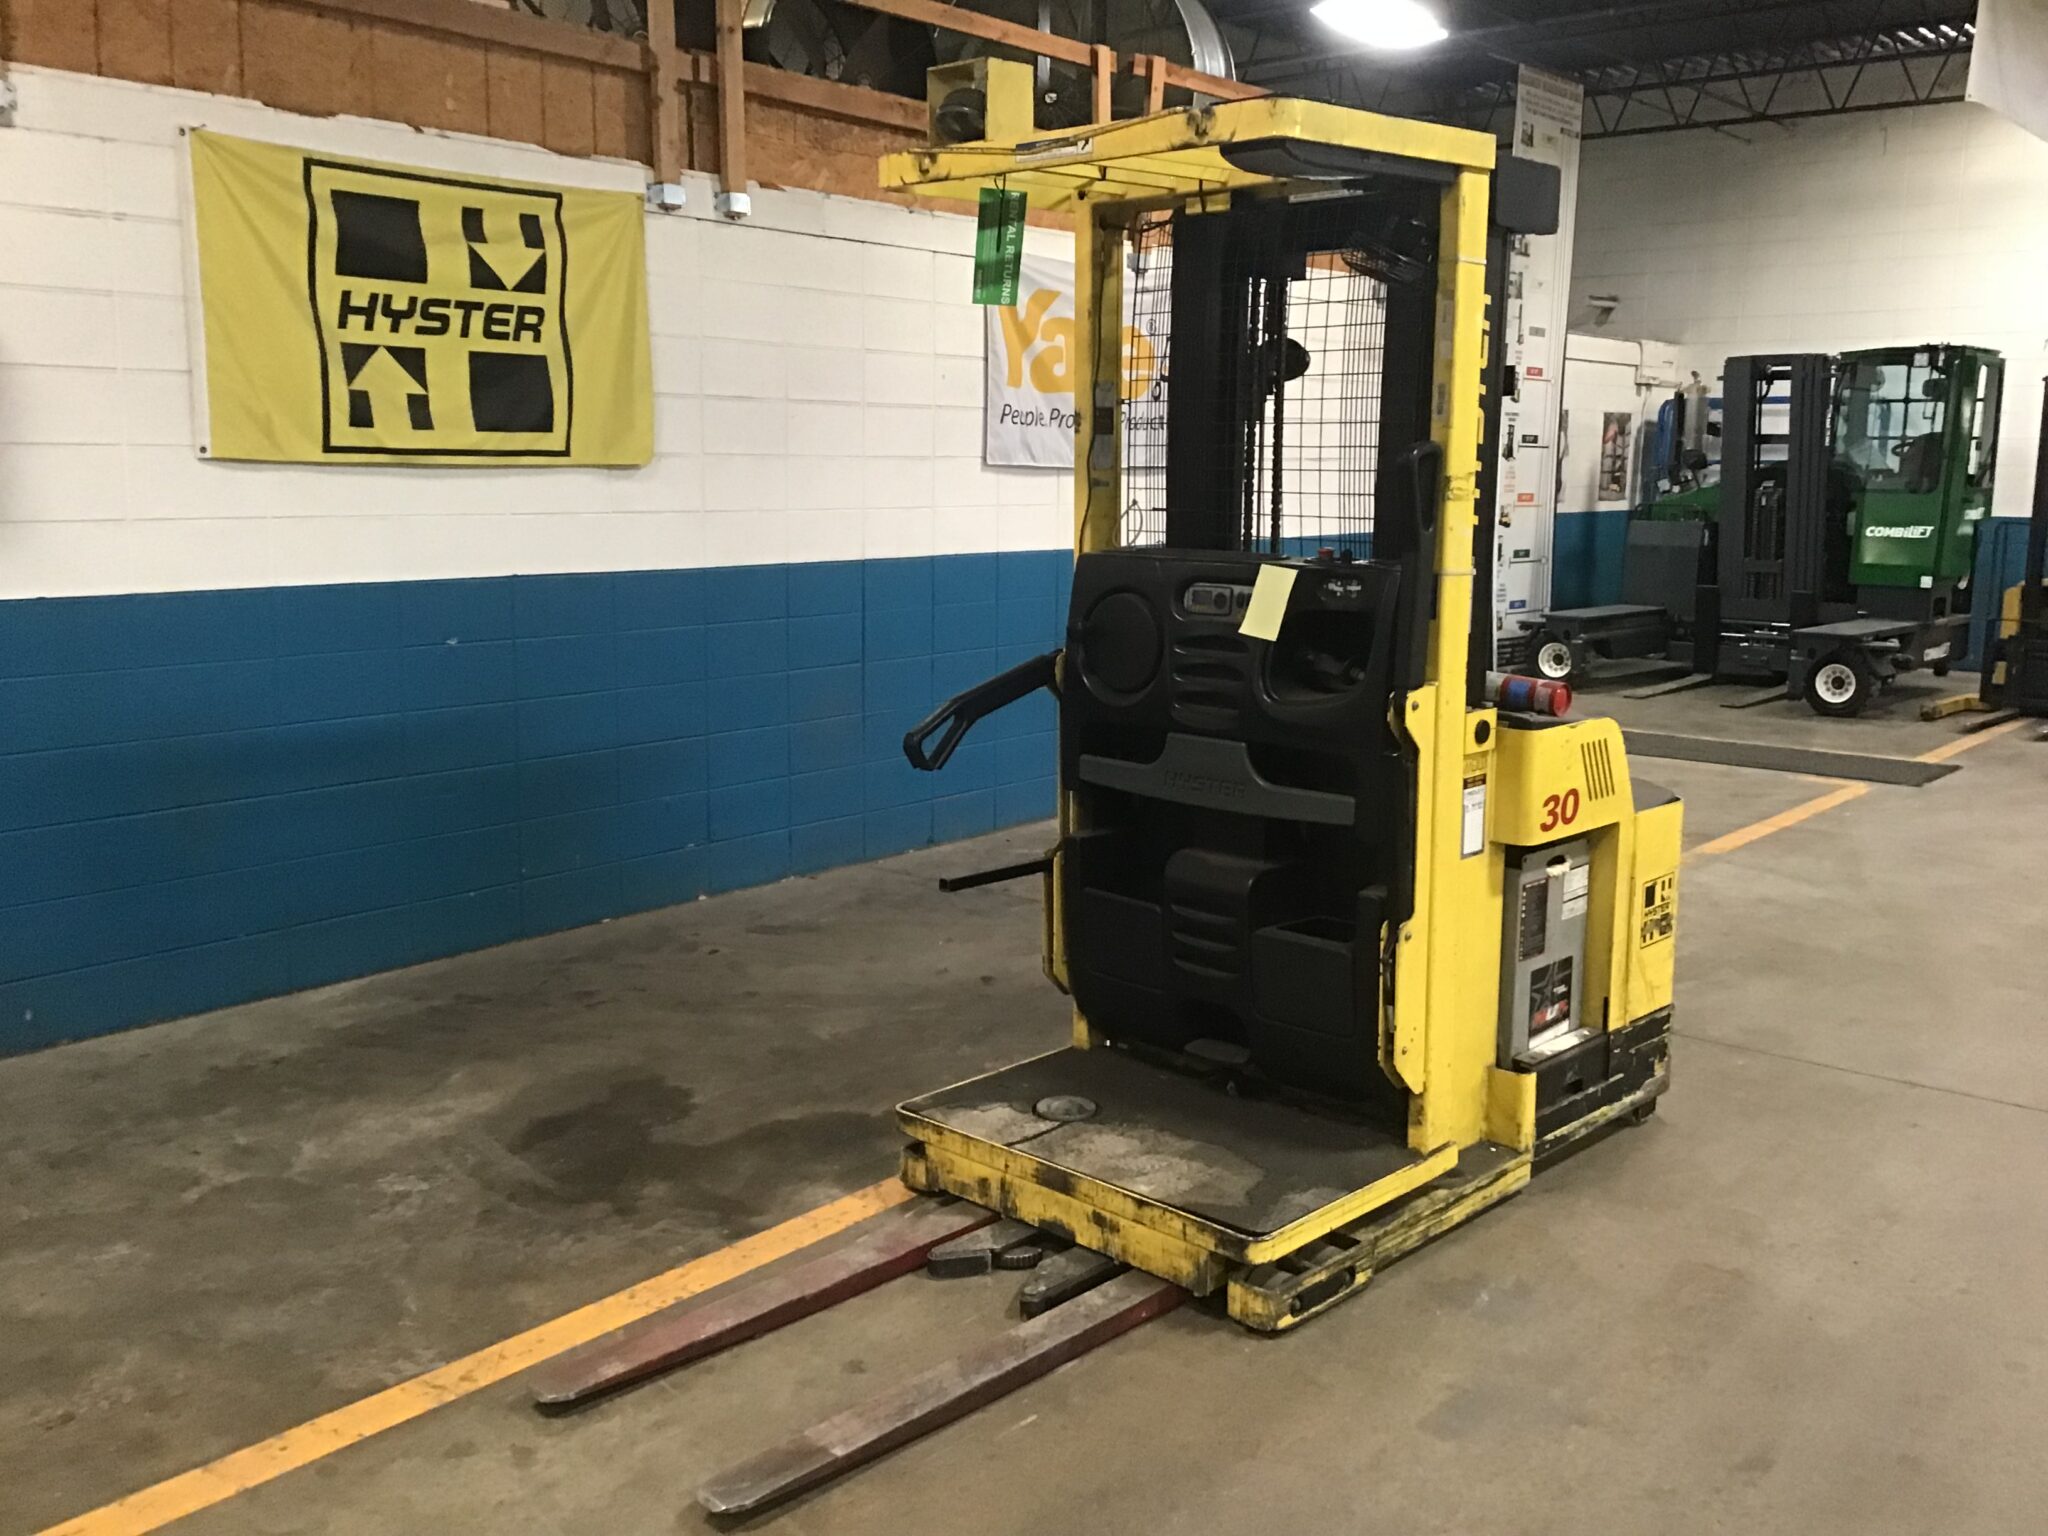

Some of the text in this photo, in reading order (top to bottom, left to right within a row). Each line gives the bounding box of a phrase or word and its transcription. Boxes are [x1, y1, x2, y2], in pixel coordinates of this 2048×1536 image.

[1000, 192, 1021, 305] RENTAL RETURNS
[337, 289, 546, 343] HYSTER
[998, 287, 1155, 401] Yae
[1163, 768, 1247, 799] HYSTER
[1539, 787, 1580, 833] 30
